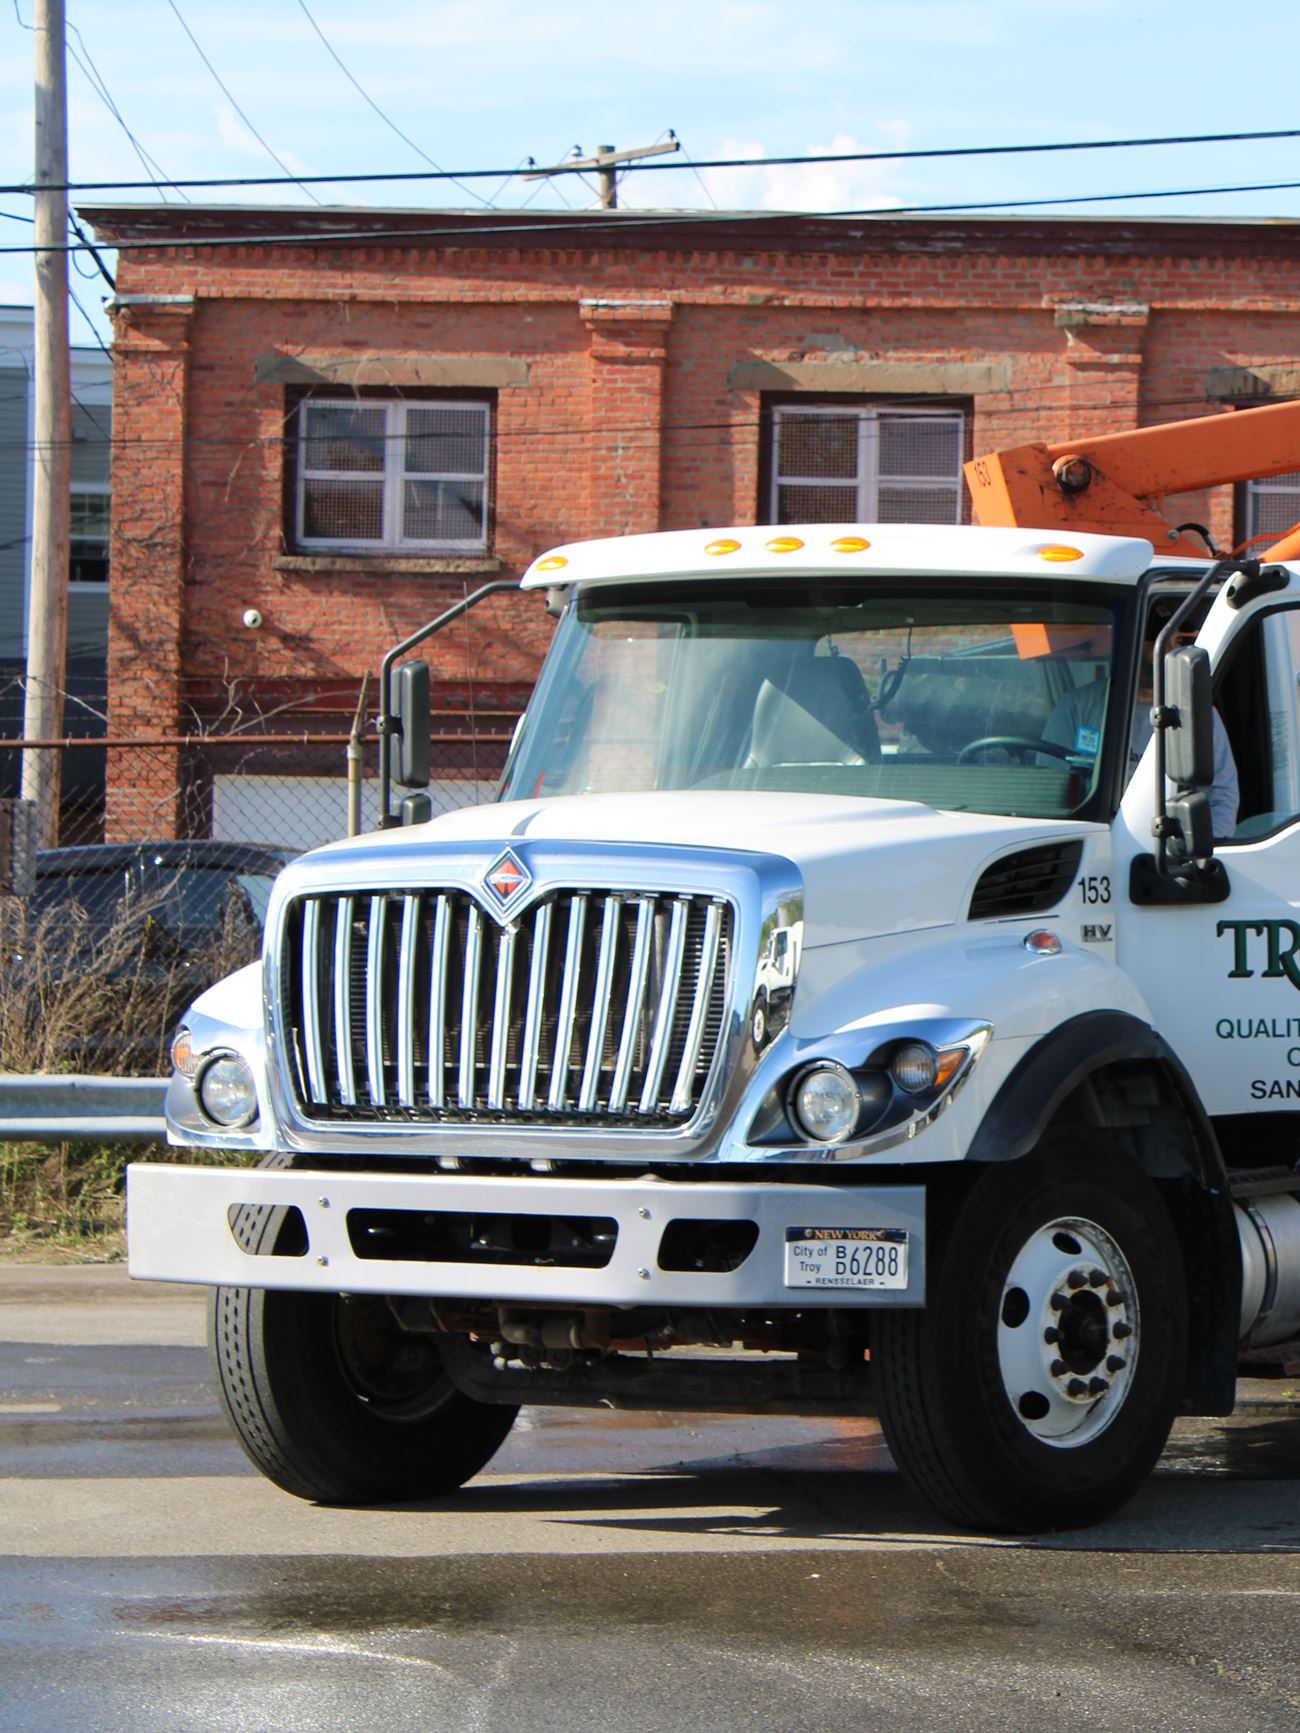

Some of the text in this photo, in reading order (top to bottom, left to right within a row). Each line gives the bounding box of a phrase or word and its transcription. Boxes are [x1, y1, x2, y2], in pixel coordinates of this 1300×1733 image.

[1077, 875, 1112, 904] 153
[1082, 923, 1113, 938] HV
[815, 1230, 877, 1240] NEW YORK
[793, 1246, 828, 1258] City of
[800, 1261, 822, 1274] Troy
